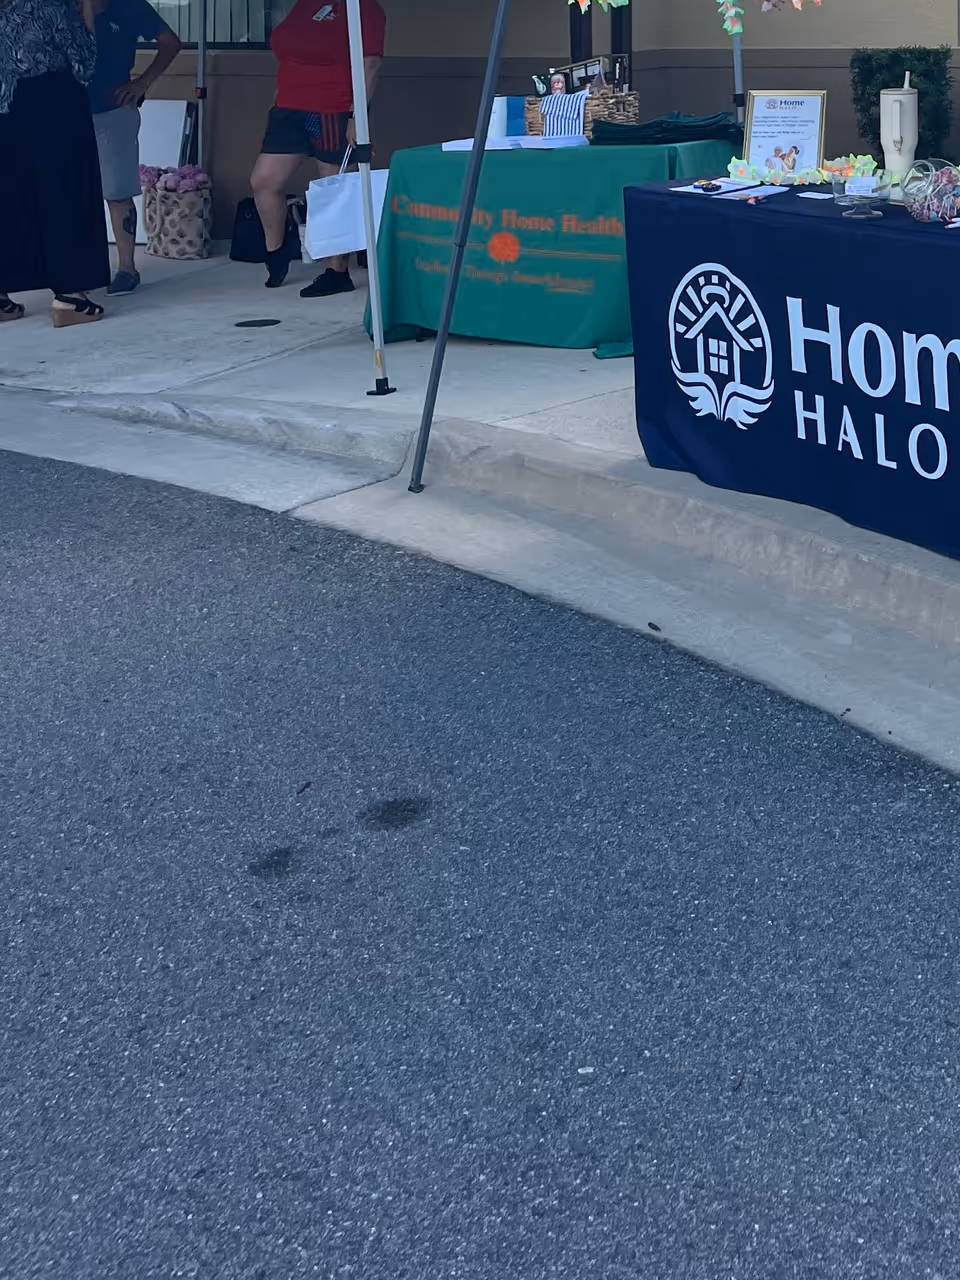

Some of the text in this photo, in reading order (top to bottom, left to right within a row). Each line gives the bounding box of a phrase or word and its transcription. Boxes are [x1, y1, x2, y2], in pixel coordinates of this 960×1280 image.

[391, 195, 624, 235] Commuity Home Health
[794, 389, 948, 479] HALO
